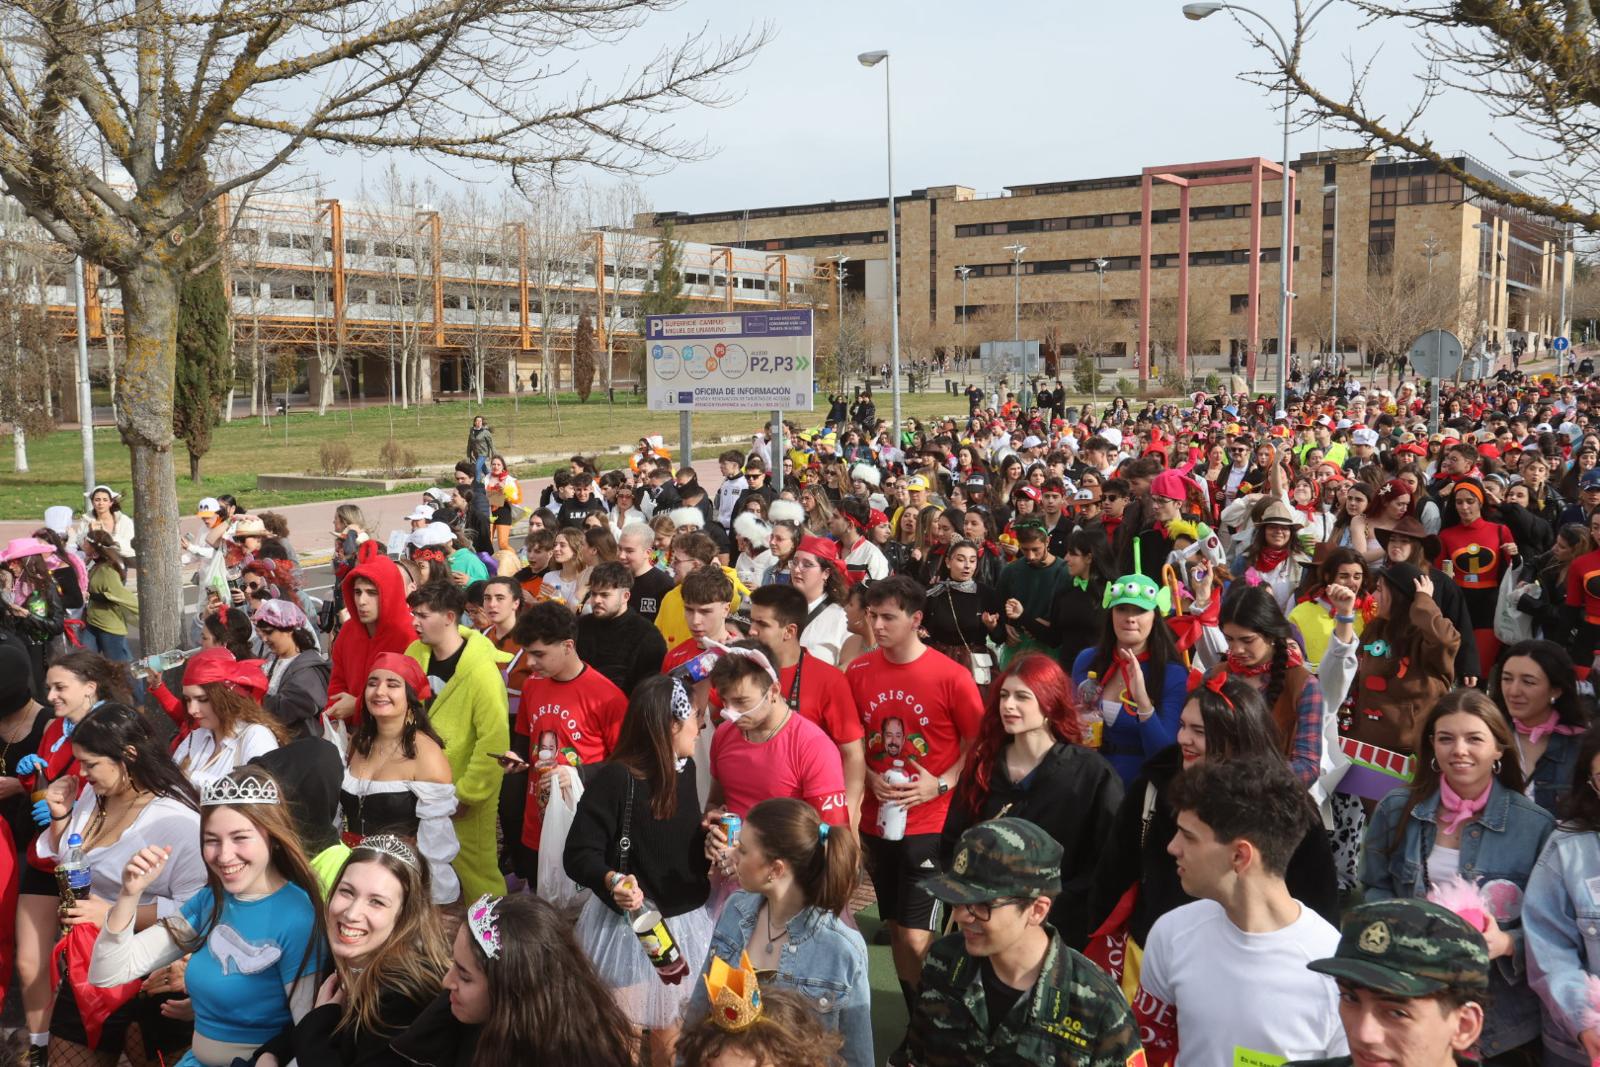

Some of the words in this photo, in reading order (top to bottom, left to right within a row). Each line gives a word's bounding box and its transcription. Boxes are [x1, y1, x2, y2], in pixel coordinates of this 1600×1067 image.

[651, 320, 663, 336] P
[751, 356, 793, 374] P2,P3
[694, 387, 724, 395] OFICINA
[726, 387, 736, 395] DE
[737, 385, 791, 395] INFORMACIÓN
[640, 598, 656, 612] RR
